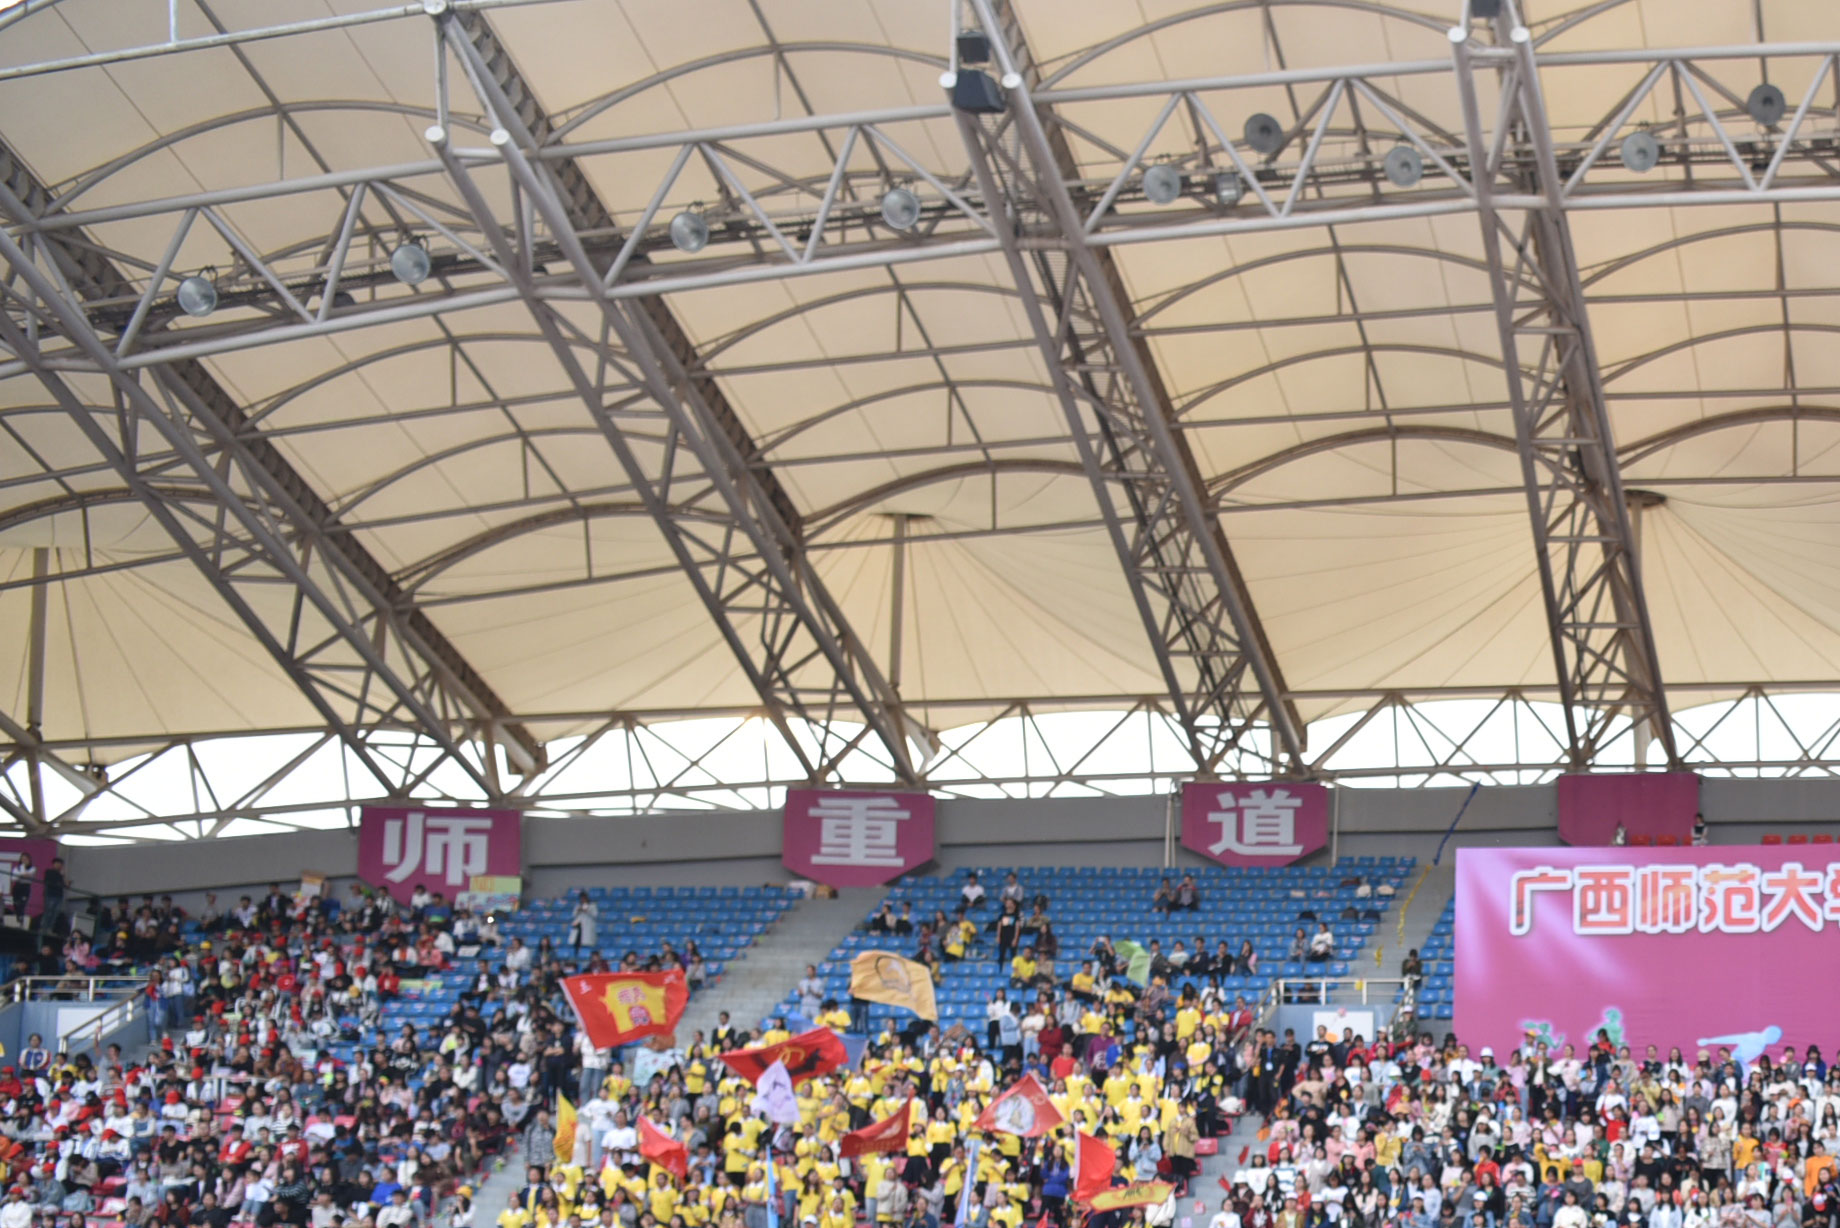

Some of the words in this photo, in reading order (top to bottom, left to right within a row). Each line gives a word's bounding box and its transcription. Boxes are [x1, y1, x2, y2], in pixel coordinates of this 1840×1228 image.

[382, 811, 492, 886] 师
[808, 796, 911, 868] 重
[1207, 788, 1304, 857] 道
